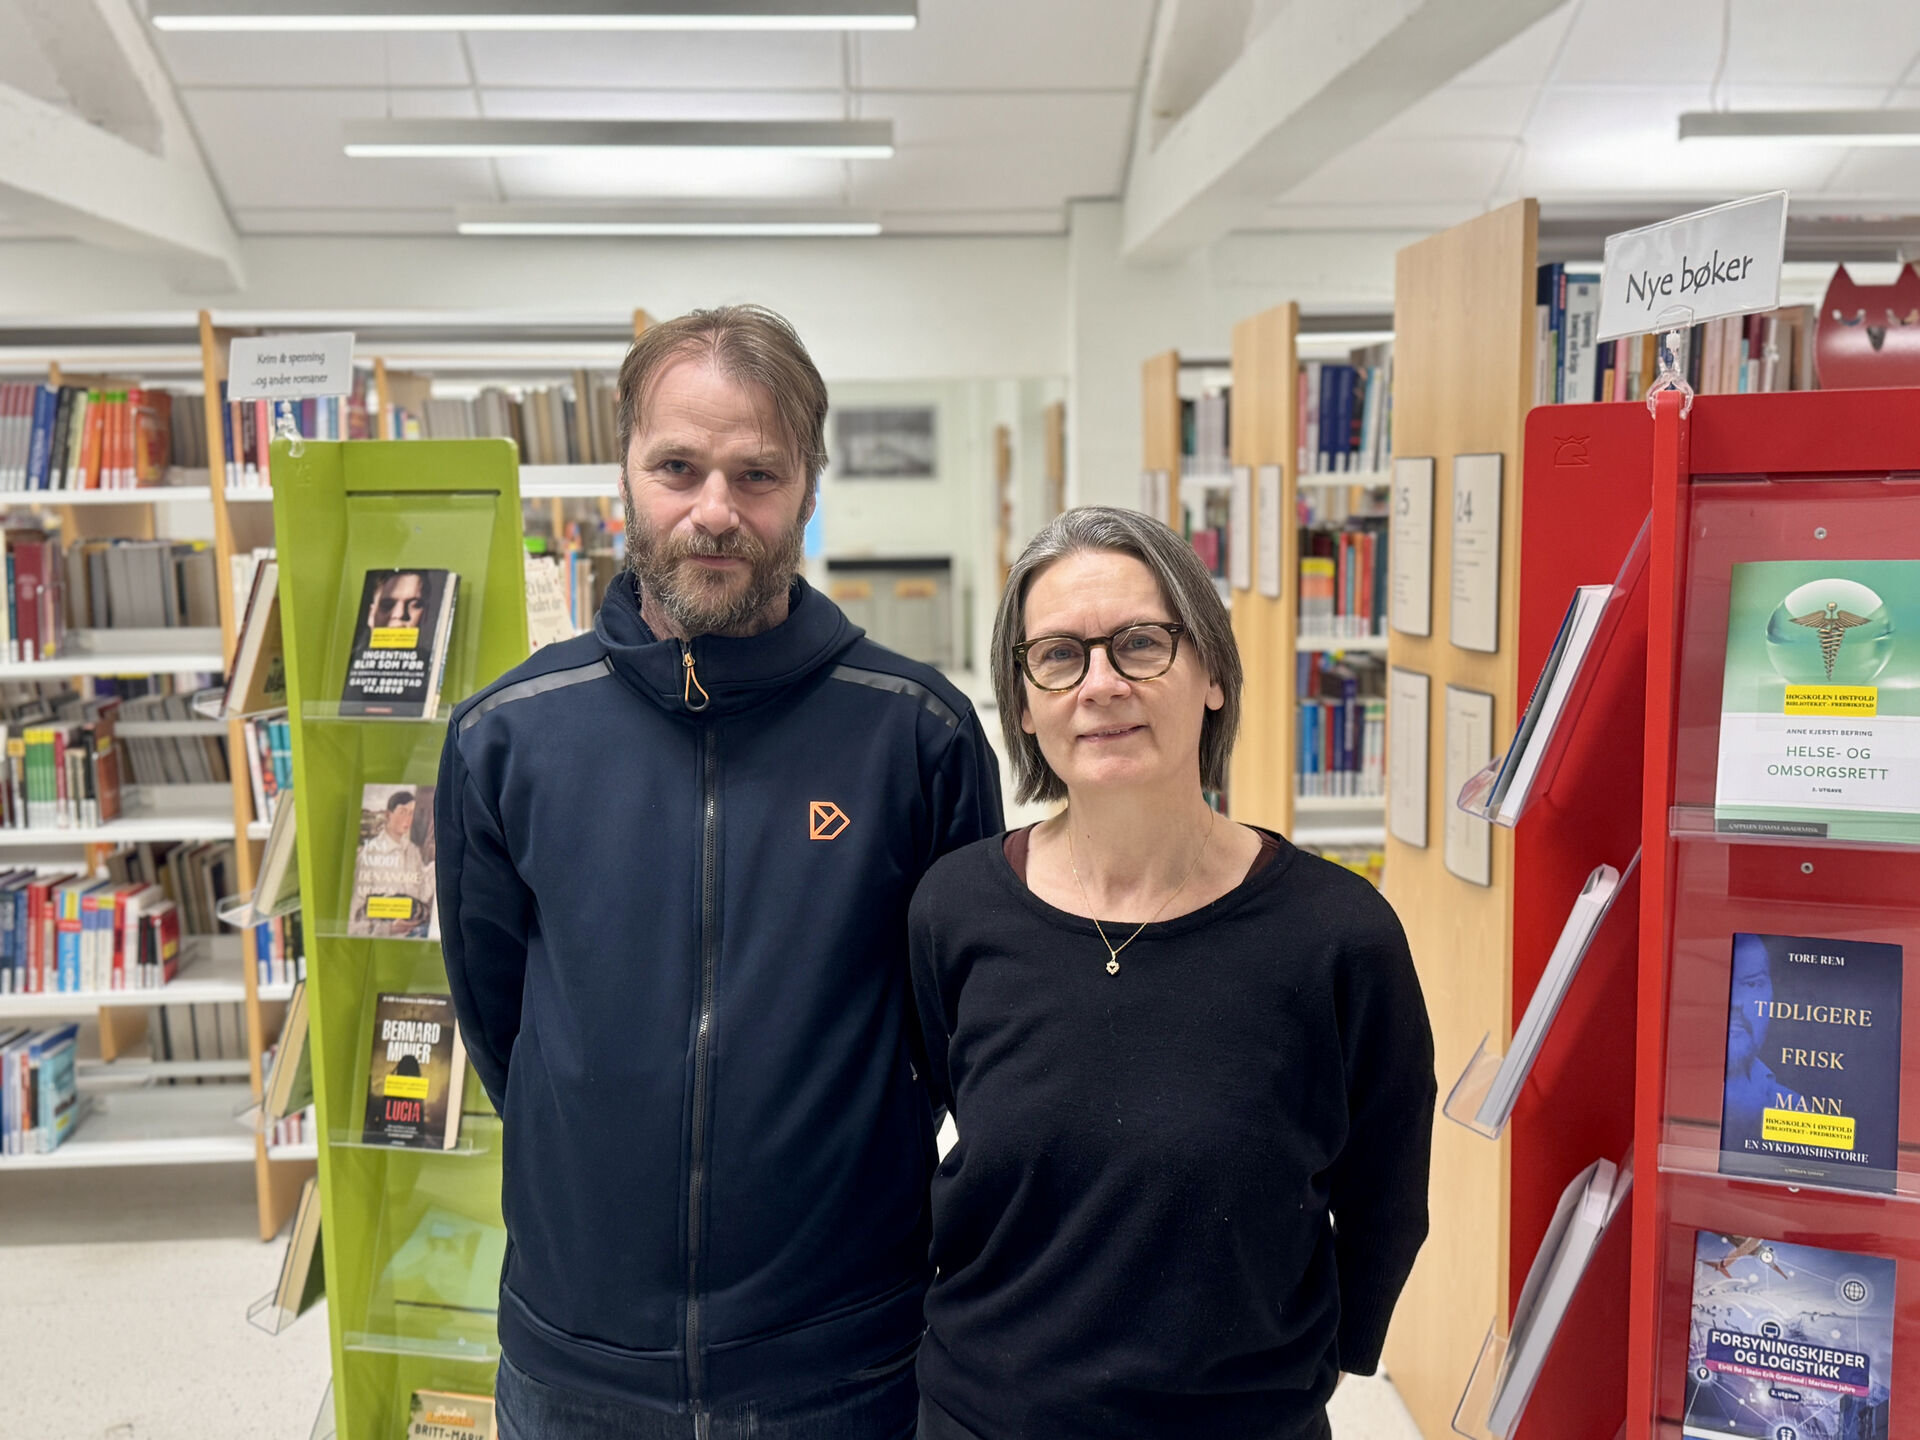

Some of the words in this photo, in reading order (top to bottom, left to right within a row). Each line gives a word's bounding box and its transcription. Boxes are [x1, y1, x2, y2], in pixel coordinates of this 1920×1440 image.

[1626, 270, 1673, 311] Nye
[1680, 250, 1753, 294] bøker
[257, 354, 277, 364] Krim
[289, 353, 325, 366] spenning
[269, 374, 291, 385] andre
[293, 375, 328, 384] romaner
[1456, 491, 1473, 523] 24
[353, 660, 376, 669] BLIR
[377, 661, 400, 669] SOM
[401, 661, 424, 670] FØR
[362, 651, 418, 660] INGENTING
[1786, 746, 1841, 758] HELSE-
[1846, 747, 1871, 760] OG
[1767, 764, 1889, 780] OMSORGSRETT
[1788, 953, 1818, 964] TORE
[1820, 955, 1845, 966] REM
[1754, 1000, 1873, 1027] TIDLIGERE
[381, 1019, 441, 1044] BERNARD
[386, 1041, 431, 1065] MINIER
[1781, 1047, 1844, 1070] FRISK
[385, 1099, 420, 1122] LUCIA
[1775, 1092, 1842, 1116] MANN
[1744, 1139, 1759, 1149] EN
[1761, 1141, 1869, 1163] SYKDOMSHISTORIE
[1712, 1331, 1865, 1368] FORSYNINGSKJEDER
[1734, 1350, 1757, 1364] OG
[1760, 1354, 1840, 1379] LOGISTIKK
[1808, 1379, 1838, 1390] Marianne
